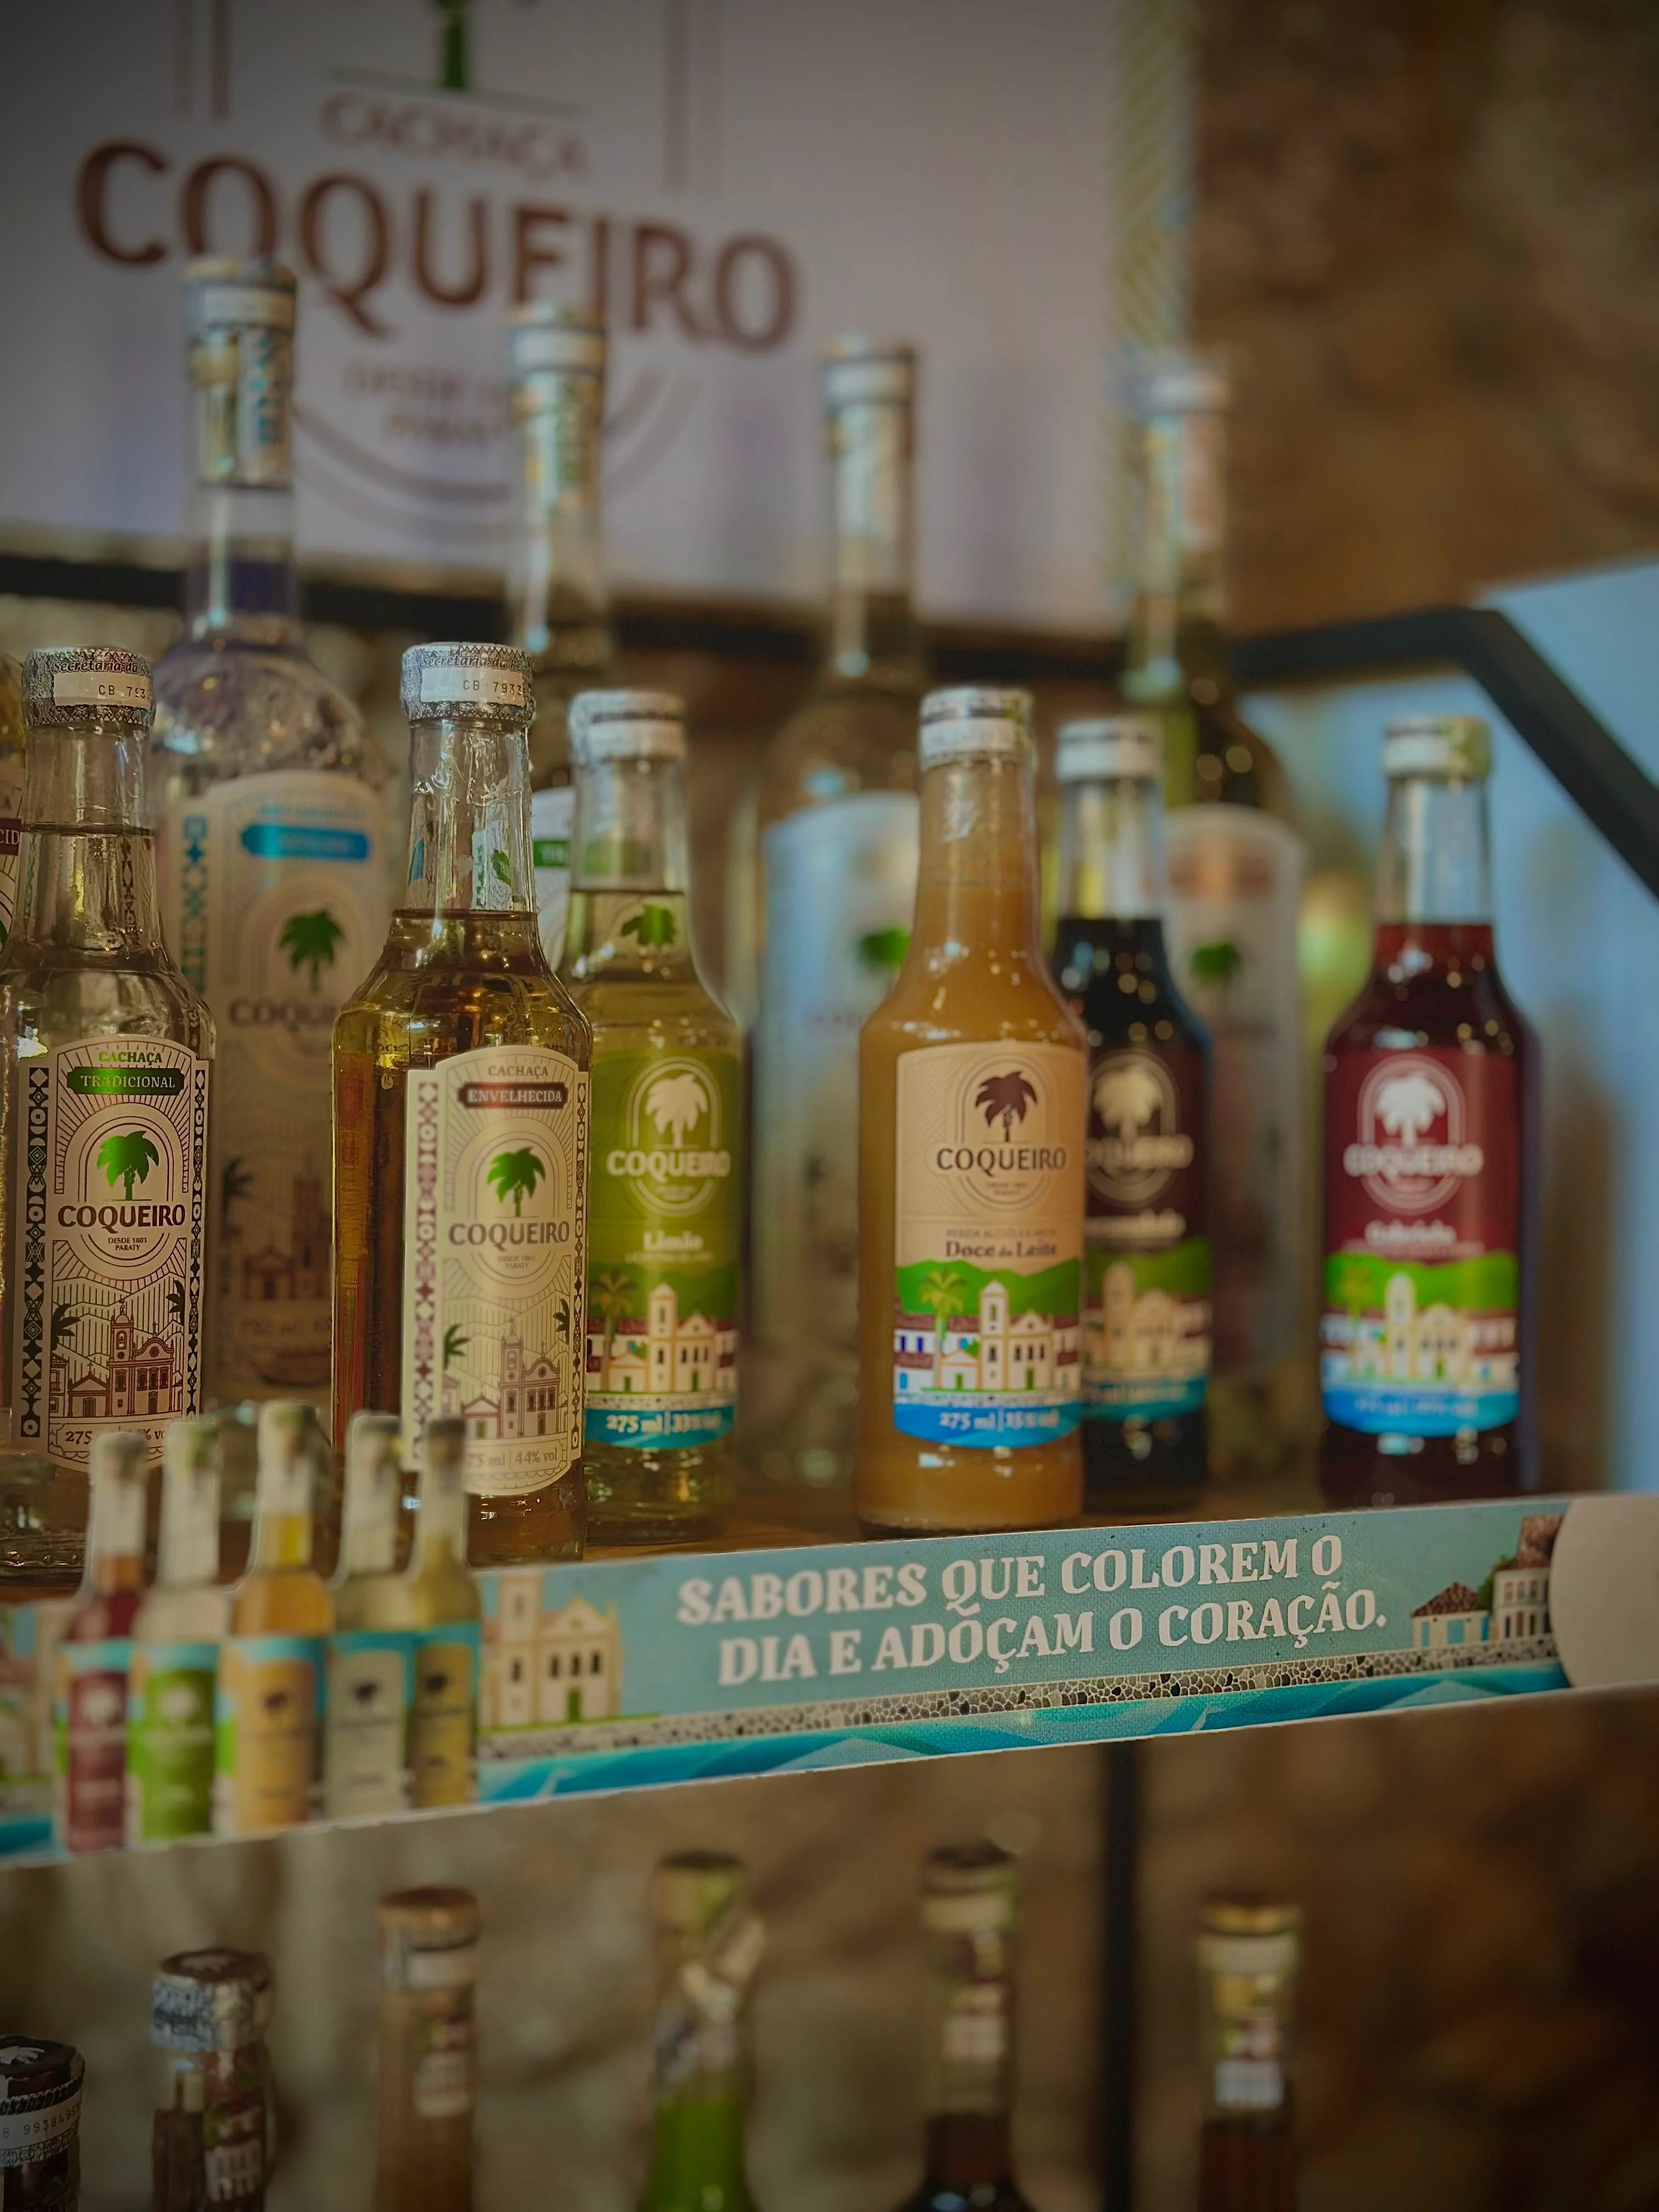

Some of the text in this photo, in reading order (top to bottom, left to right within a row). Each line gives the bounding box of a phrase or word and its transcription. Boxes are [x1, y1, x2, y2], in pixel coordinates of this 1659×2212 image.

[76, 138, 798, 351] COQUEIRO
[99, 685, 115, 695] CB
[463, 680, 479, 691] CB
[98, 1051, 162, 1065] CACHAÇA
[488, 1065, 549, 1079] CACHAÇA
[80, 1075, 176, 1088] TRADICIONAL
[469, 1089, 562, 1102] ENVELHECIDA
[937, 1147, 1066, 1177] COQUEIRO
[58, 1204, 185, 1234] COQUEIRO
[449, 1220, 570, 1252] COQUEIRO
[946, 1241, 995, 1257] Doce
[65, 1430, 92, 1444] 275
[515, 1450, 540, 1465] 44%
[543, 1447, 557, 1462] vol
[676, 1535, 1342, 1625] SABORES QUE COLOREM O
[718, 1581, 1387, 1686] DIA E ADOÇAM O CORAÇÃO.
